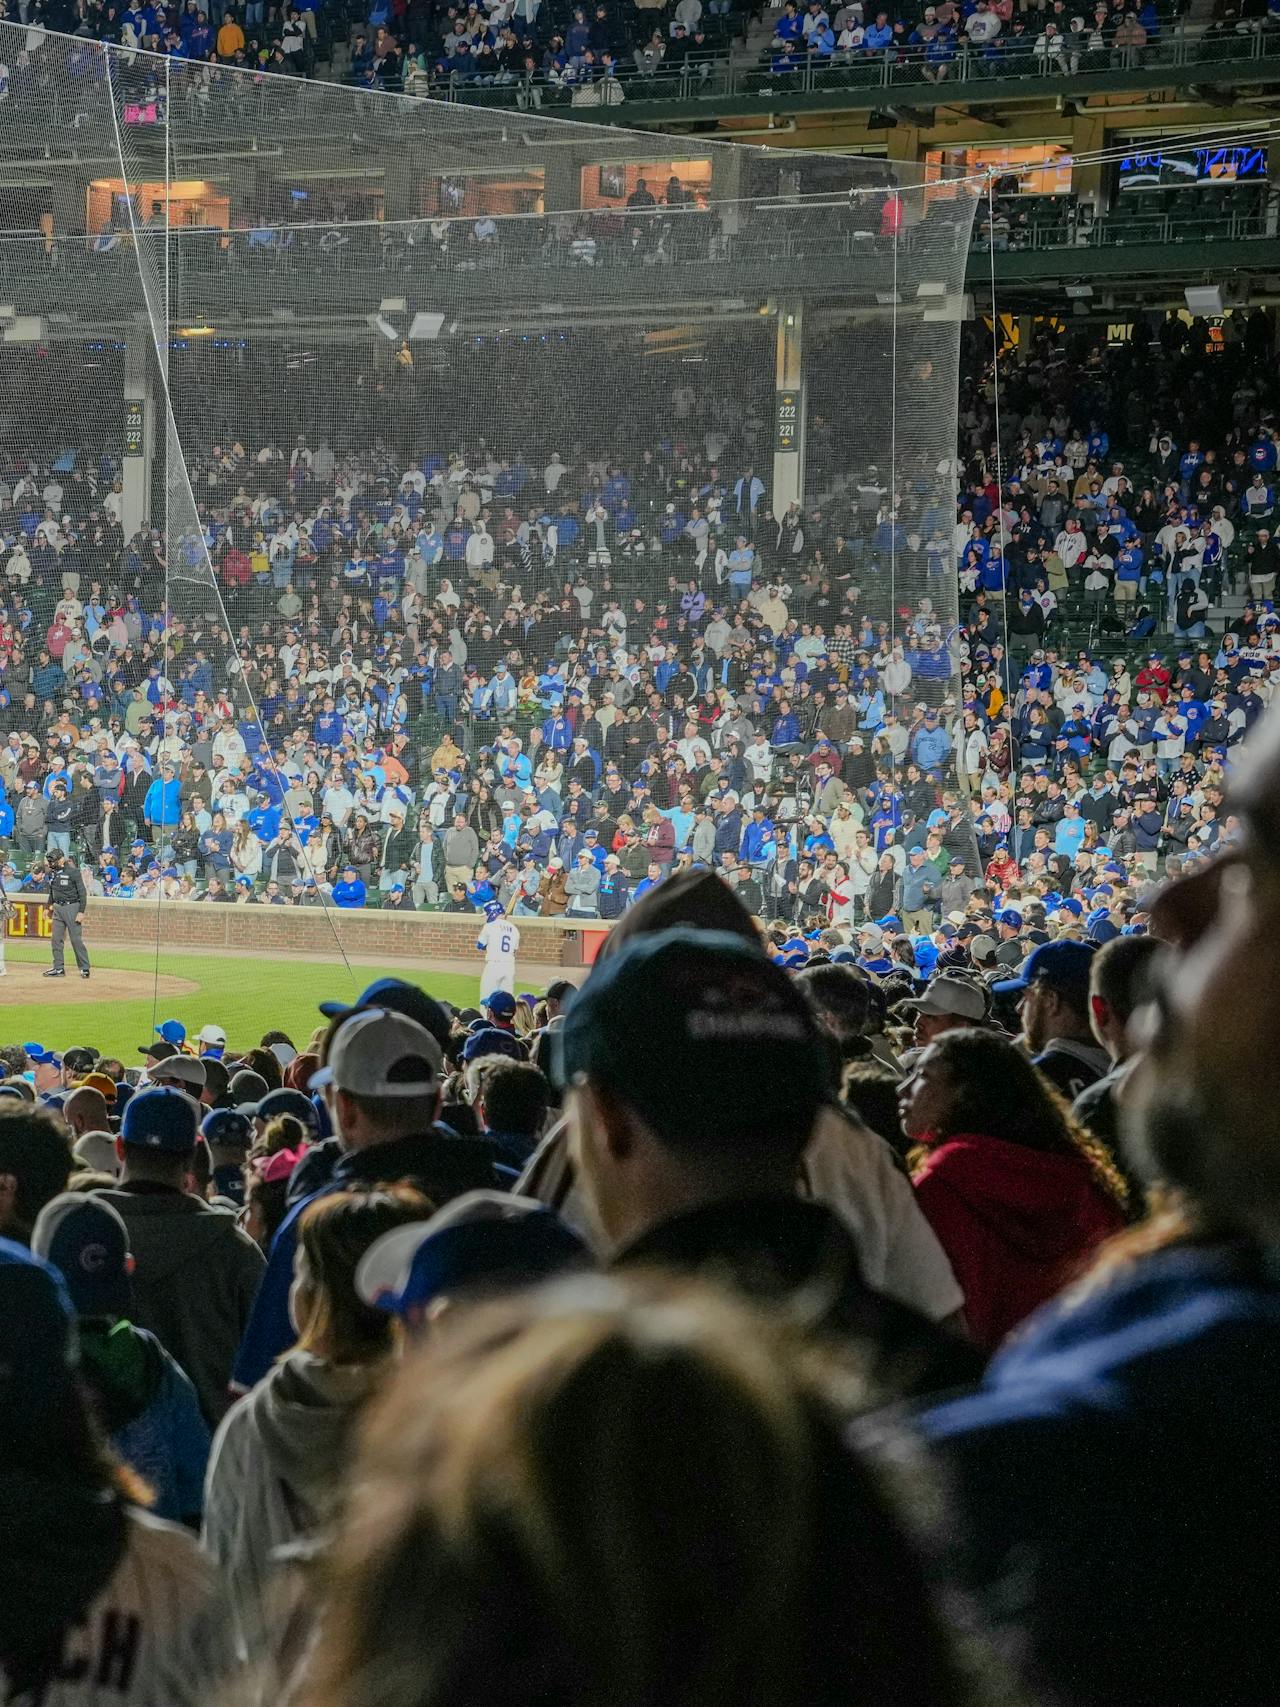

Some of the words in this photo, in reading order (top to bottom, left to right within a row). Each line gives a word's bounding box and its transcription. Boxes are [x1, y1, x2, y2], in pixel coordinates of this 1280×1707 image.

[779, 406, 796, 417] 222
[127, 415, 141, 425] 223
[779, 425, 794, 436] 221
[127, 432, 141, 442] 222
[501, 935, 511, 953] 6
